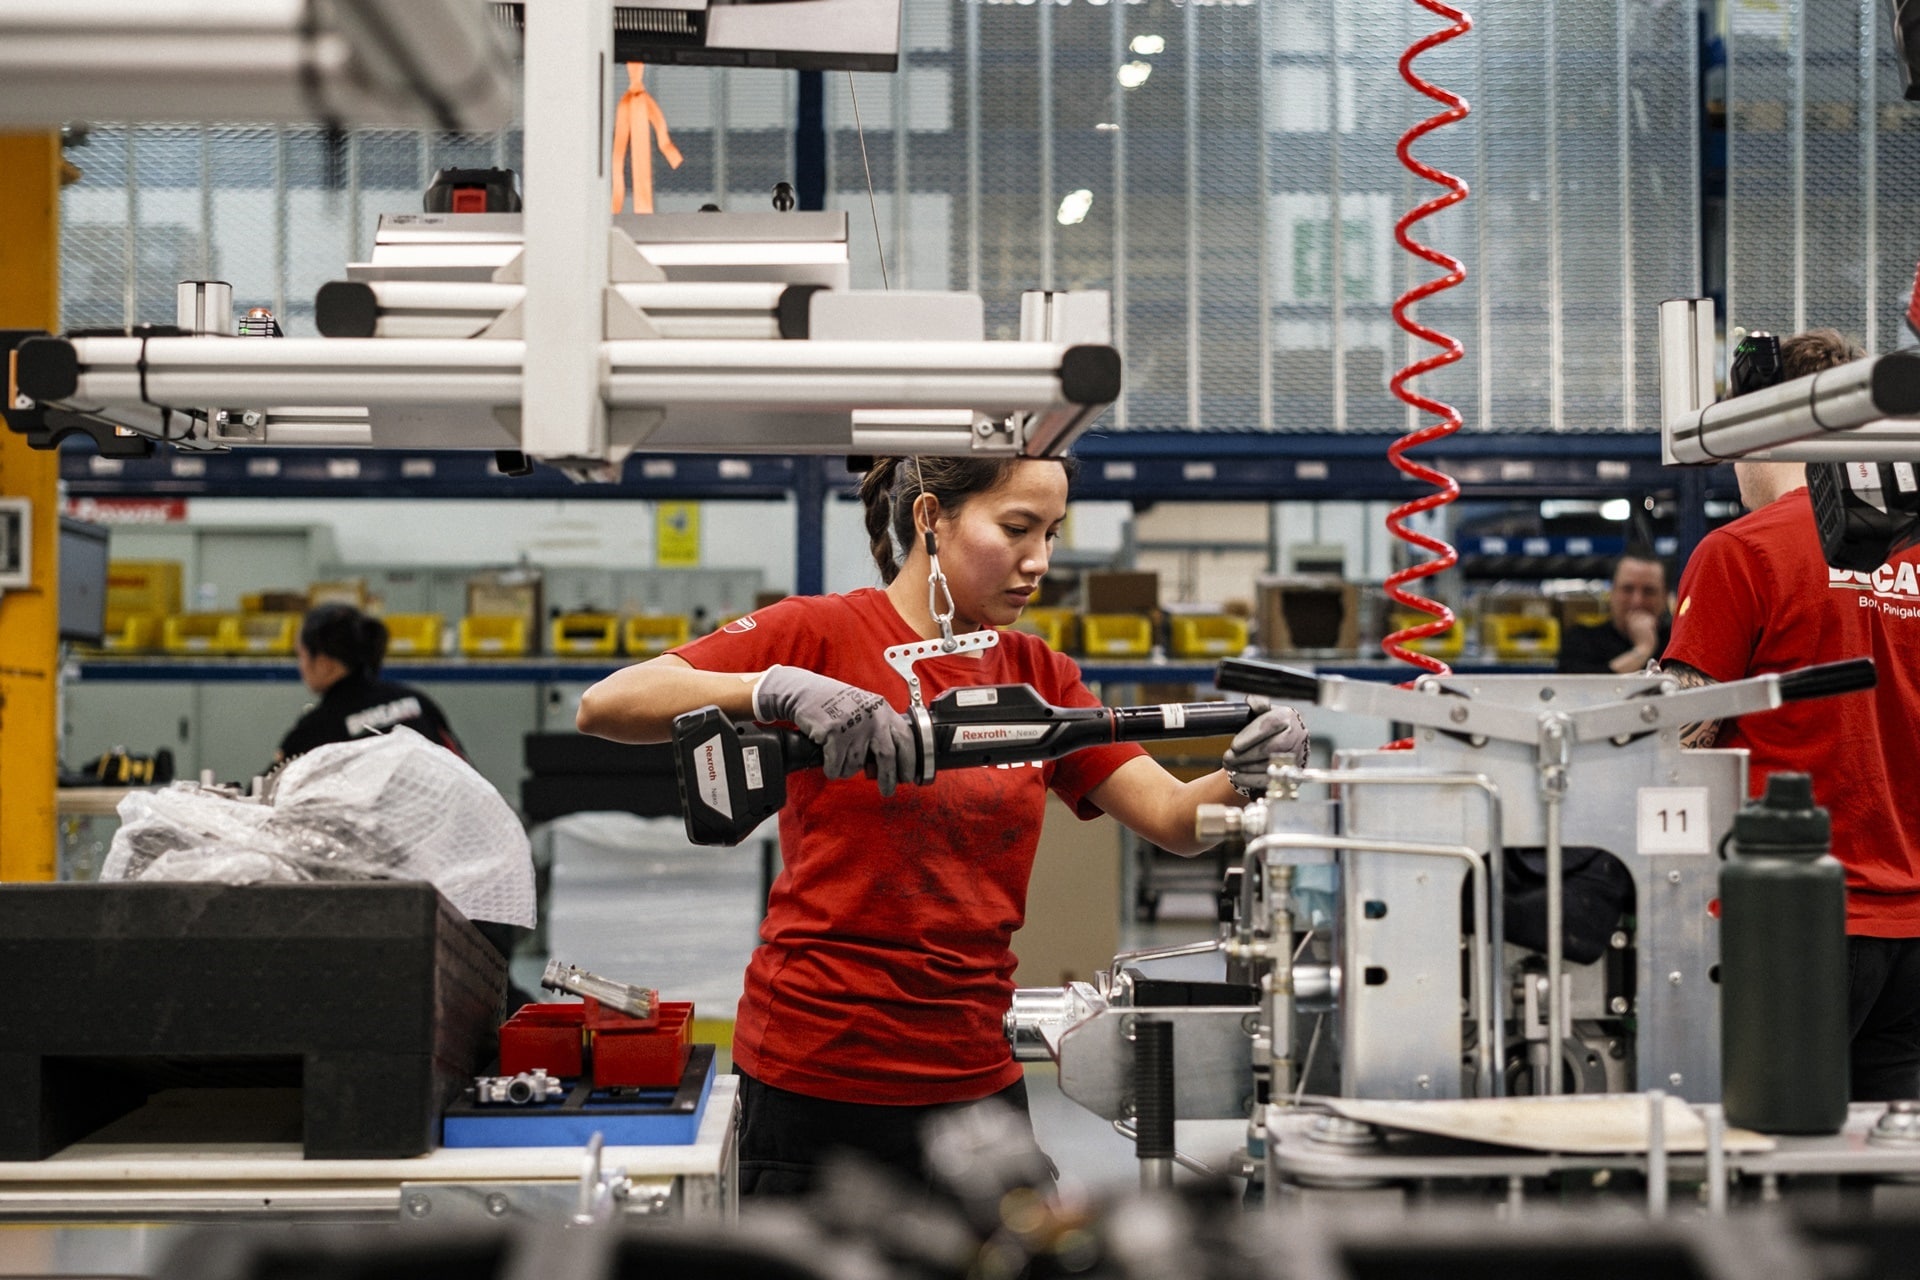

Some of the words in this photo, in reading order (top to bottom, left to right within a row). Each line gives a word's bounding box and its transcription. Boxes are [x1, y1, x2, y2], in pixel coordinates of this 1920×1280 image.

[962, 729, 1007, 740] Rexroth
[1016, 729, 1038, 737] Nexo
[705, 745, 717, 781] Rexroth
[1657, 809, 1686, 832] 11
